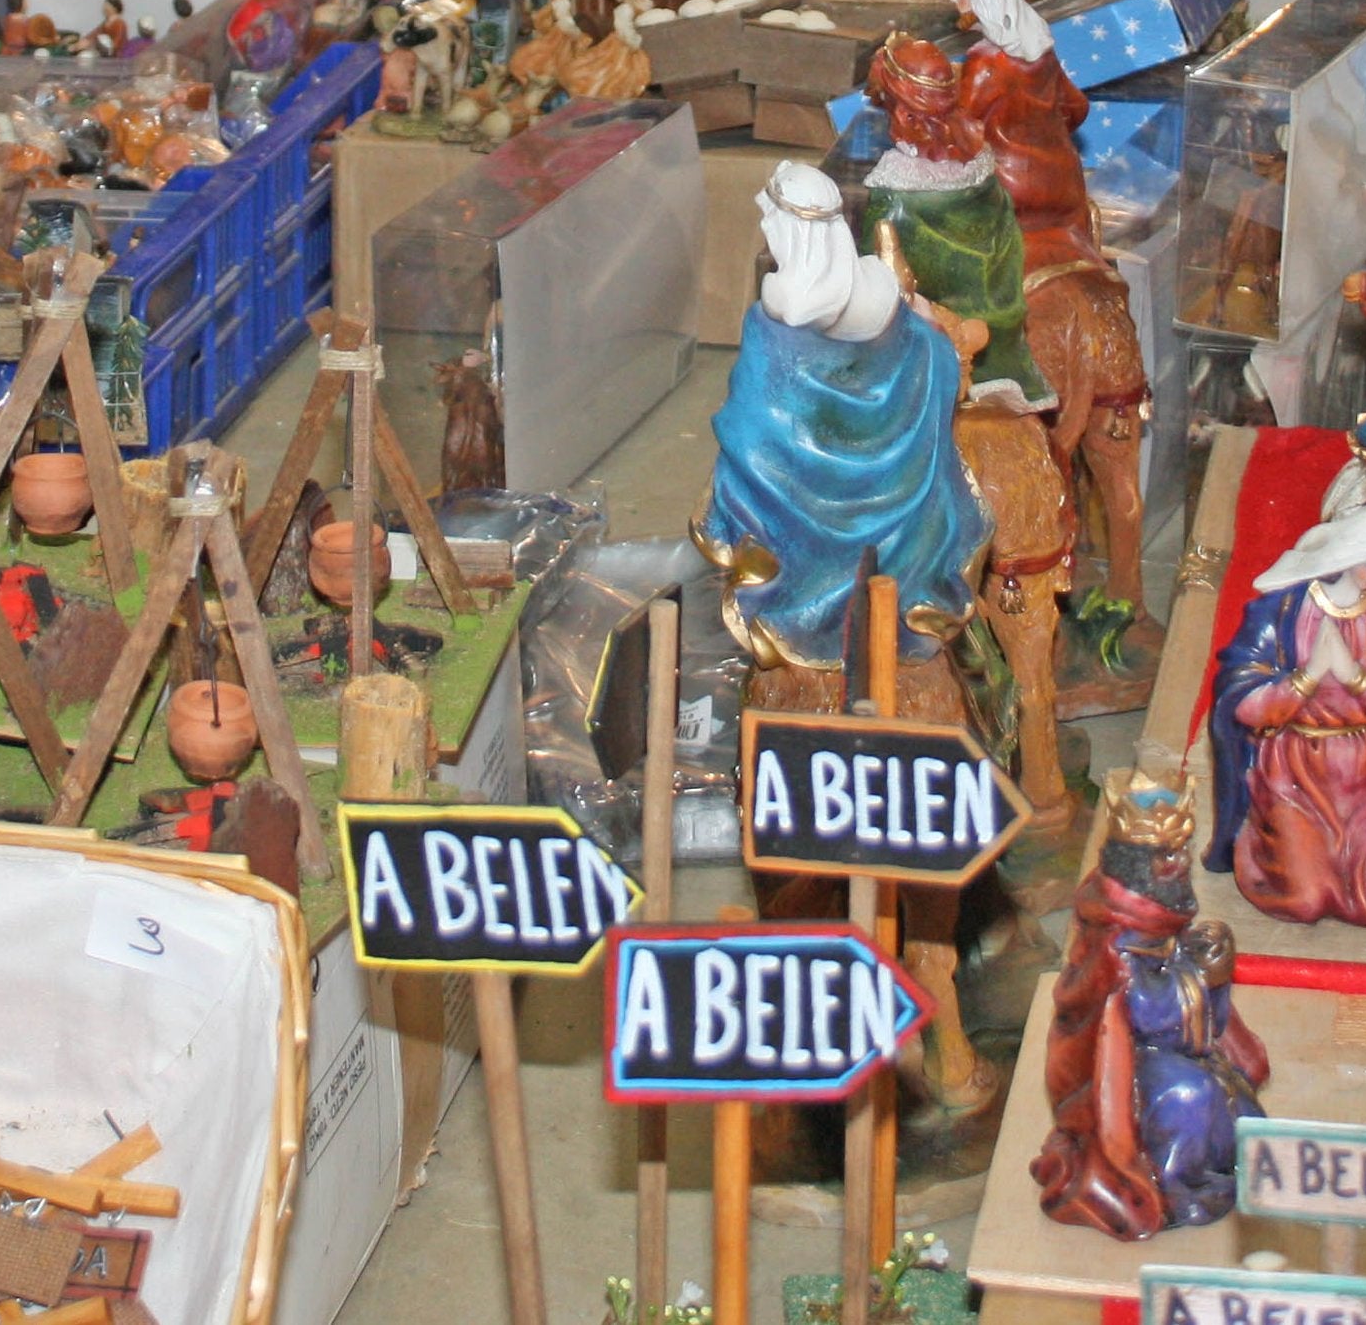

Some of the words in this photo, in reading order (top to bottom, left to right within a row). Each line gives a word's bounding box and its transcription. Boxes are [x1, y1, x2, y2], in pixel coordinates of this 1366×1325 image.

[753, 748, 792, 834] A
[810, 750, 997, 848] BELEN
[361, 830, 411, 930] A
[423, 829, 631, 943] BELEN
[621, 948, 669, 1061] A
[692, 948, 897, 1070] BELEN
[1249, 1138, 1283, 1194] A
